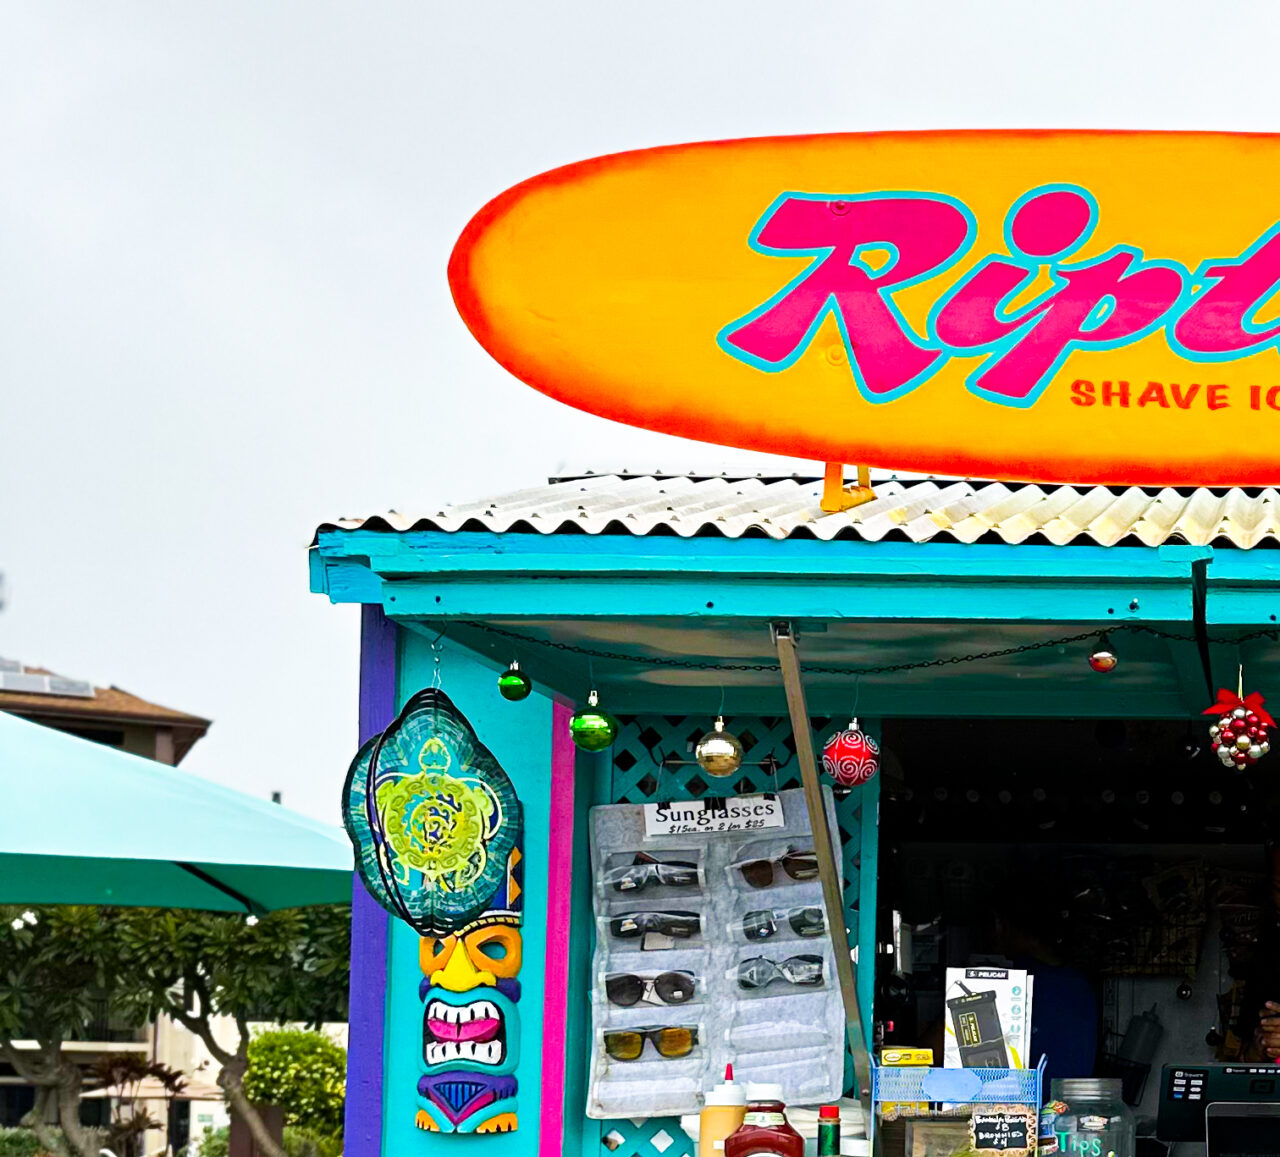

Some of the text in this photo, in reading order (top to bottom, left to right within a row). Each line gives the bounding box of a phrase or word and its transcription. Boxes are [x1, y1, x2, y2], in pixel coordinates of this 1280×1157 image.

[1070, 379, 1230, 412] SHAVE
[656, 804, 774, 825] Sunglasses
[745, 819, 765, 828] $25
